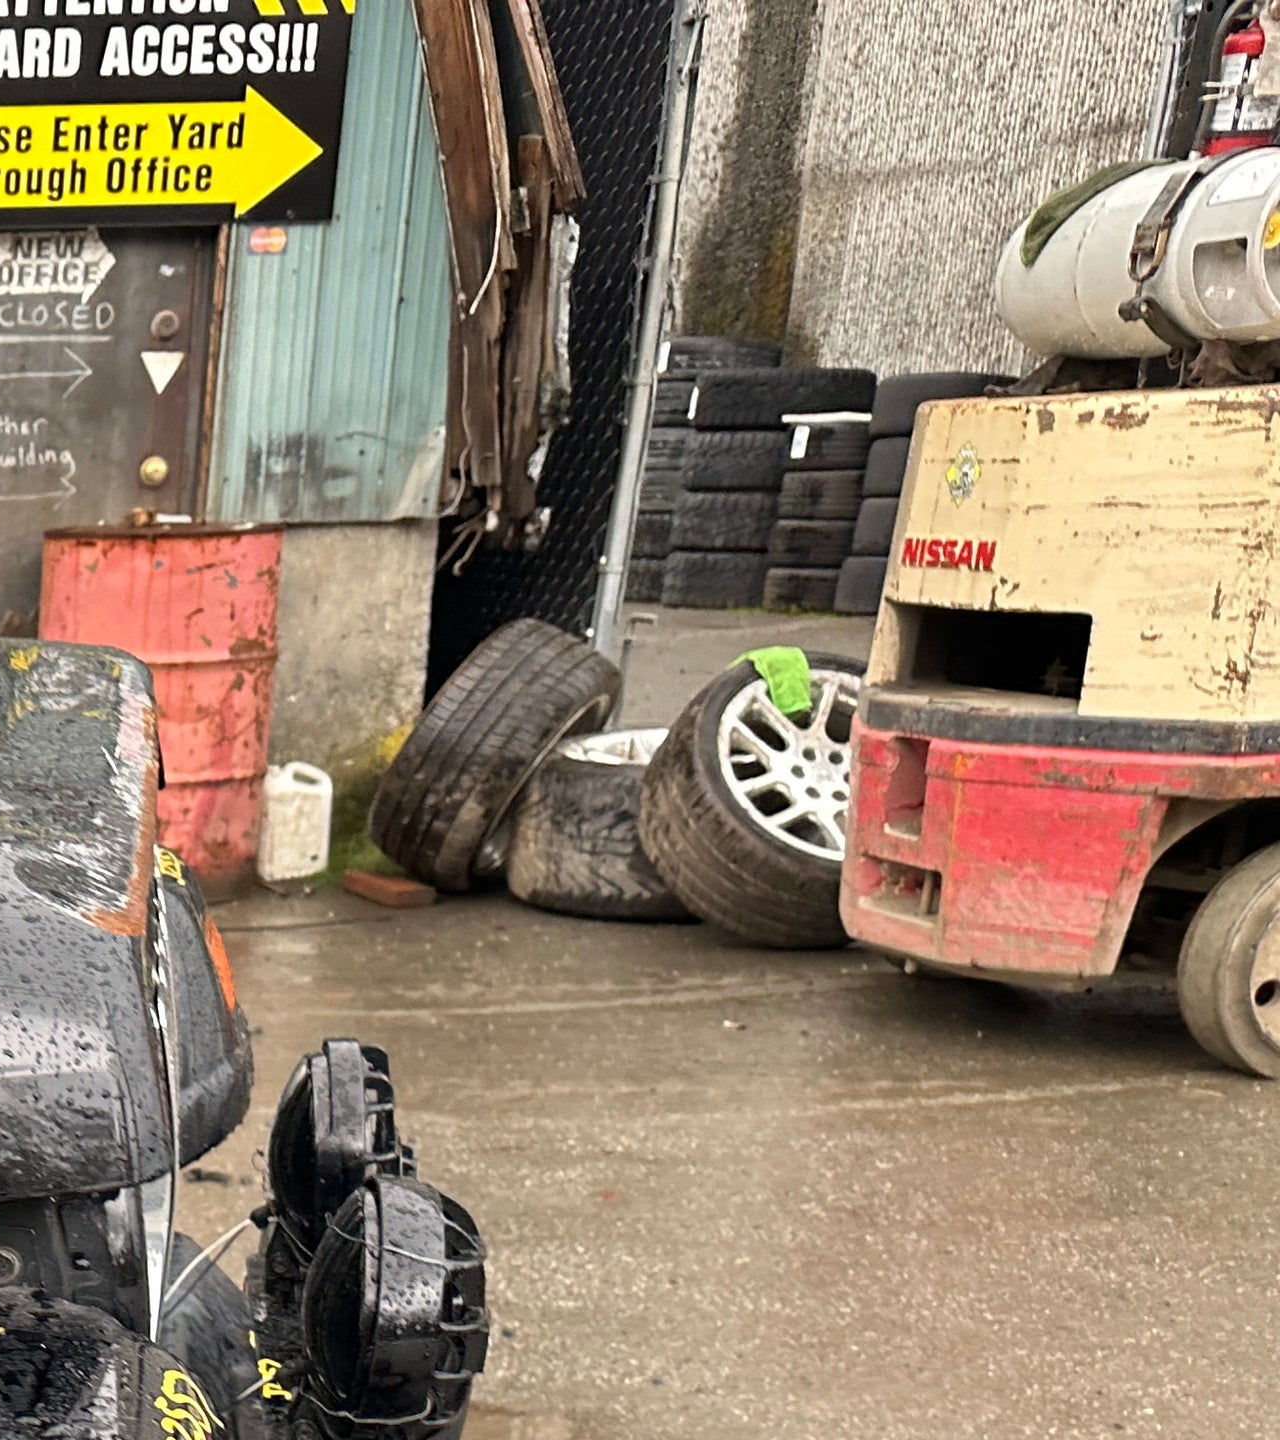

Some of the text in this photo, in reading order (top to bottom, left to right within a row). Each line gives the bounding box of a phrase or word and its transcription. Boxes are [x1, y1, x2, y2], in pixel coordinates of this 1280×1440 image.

[99, 22, 319, 77] ACCESS!!!
[52, 115, 149, 152] Enter
[168, 112, 246, 150] Yard
[105, 156, 212, 193] Office
[13, 236, 83, 259] NEW
[900, 537, 997, 572] NISSAN
